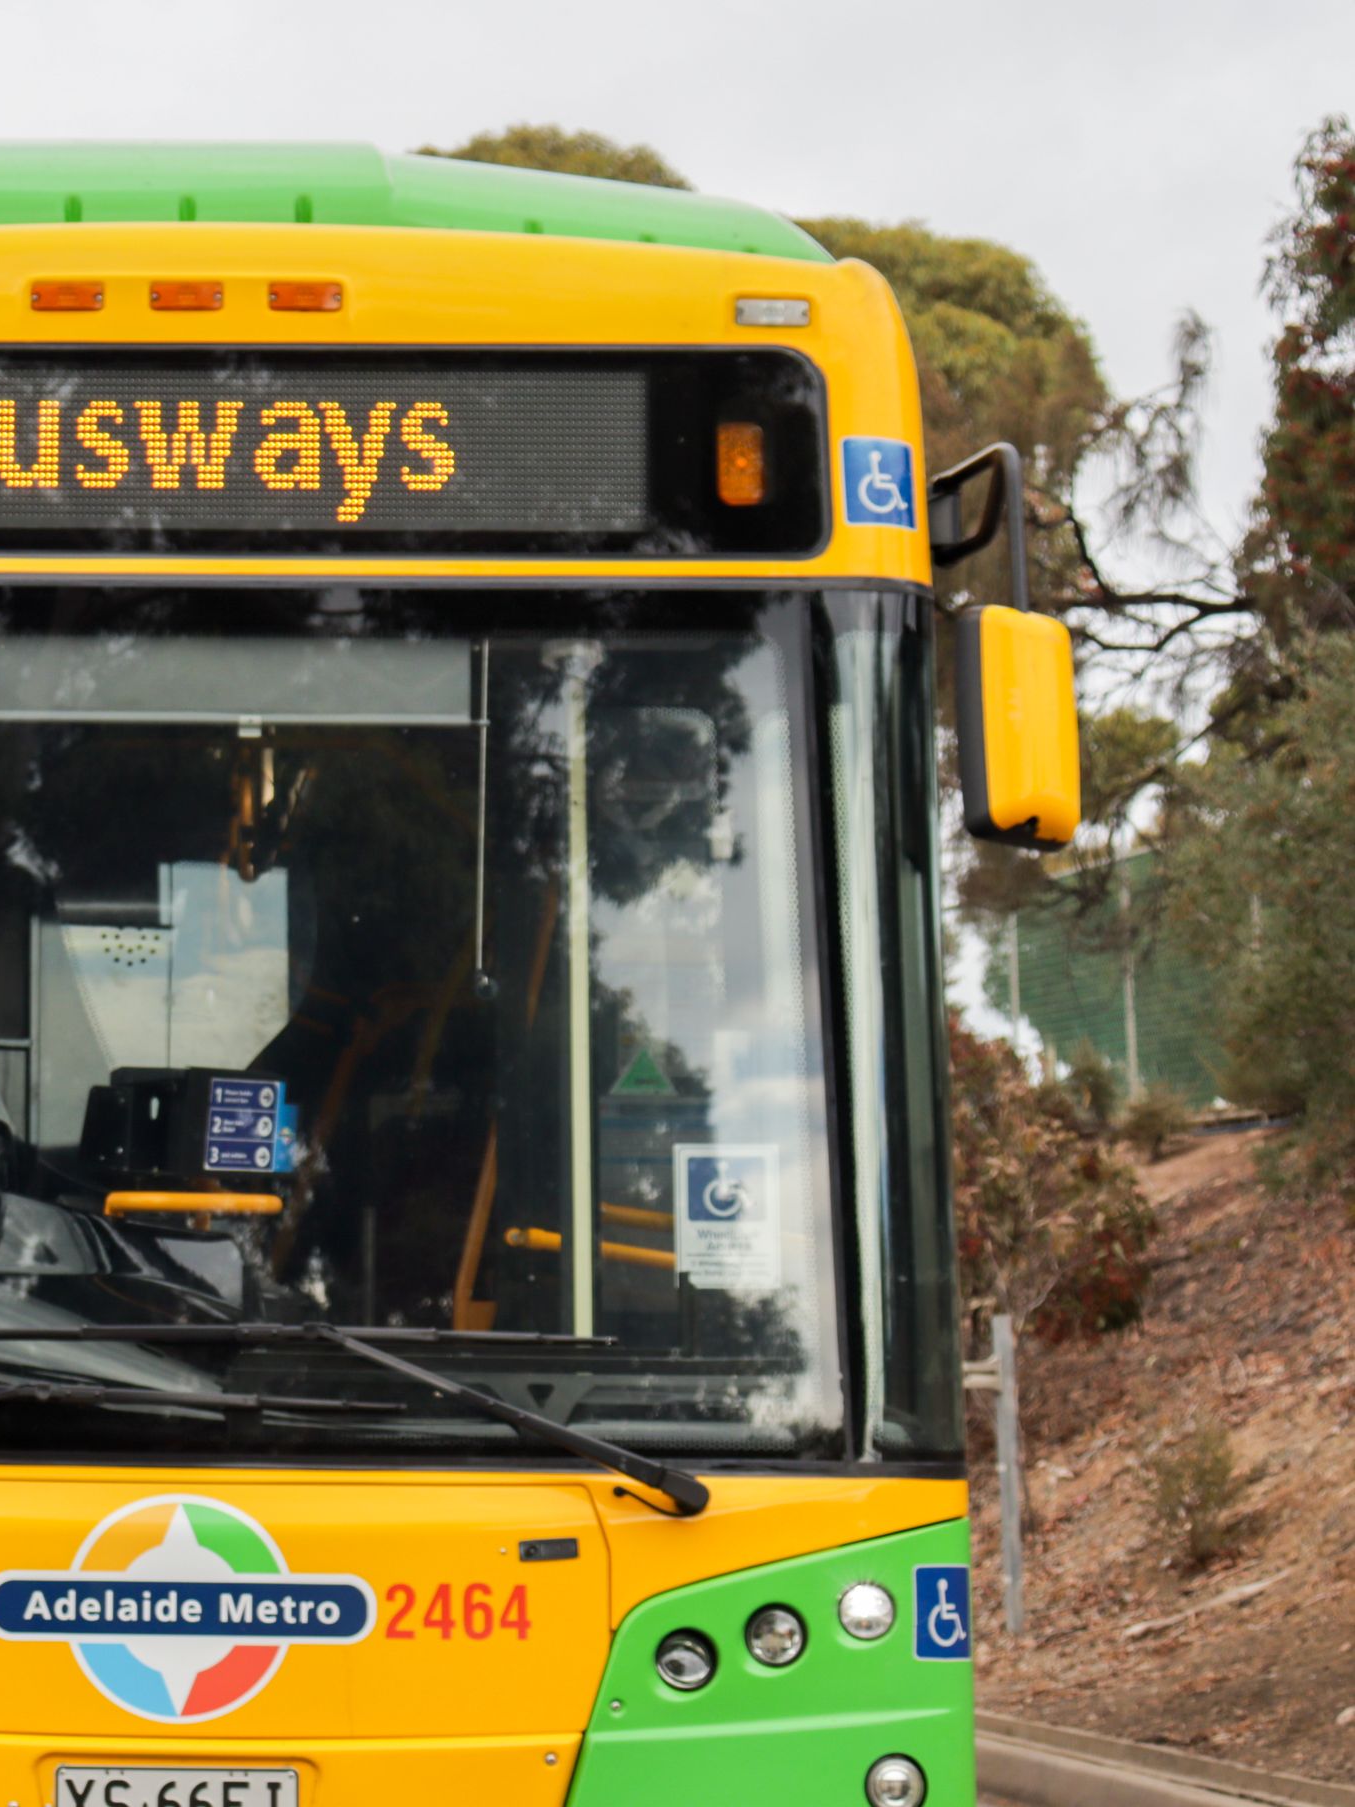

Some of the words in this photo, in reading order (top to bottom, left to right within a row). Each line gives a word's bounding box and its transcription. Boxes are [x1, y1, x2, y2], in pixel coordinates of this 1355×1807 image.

[215, 1087, 223, 1103] 1
[212, 1116, 222, 1133] 2
[209, 1146, 219, 1164] 3
[23, 1589, 203, 1623] Adelaide
[218, 1593, 341, 1624] Metro
[385, 1582, 532, 1641] 2464
